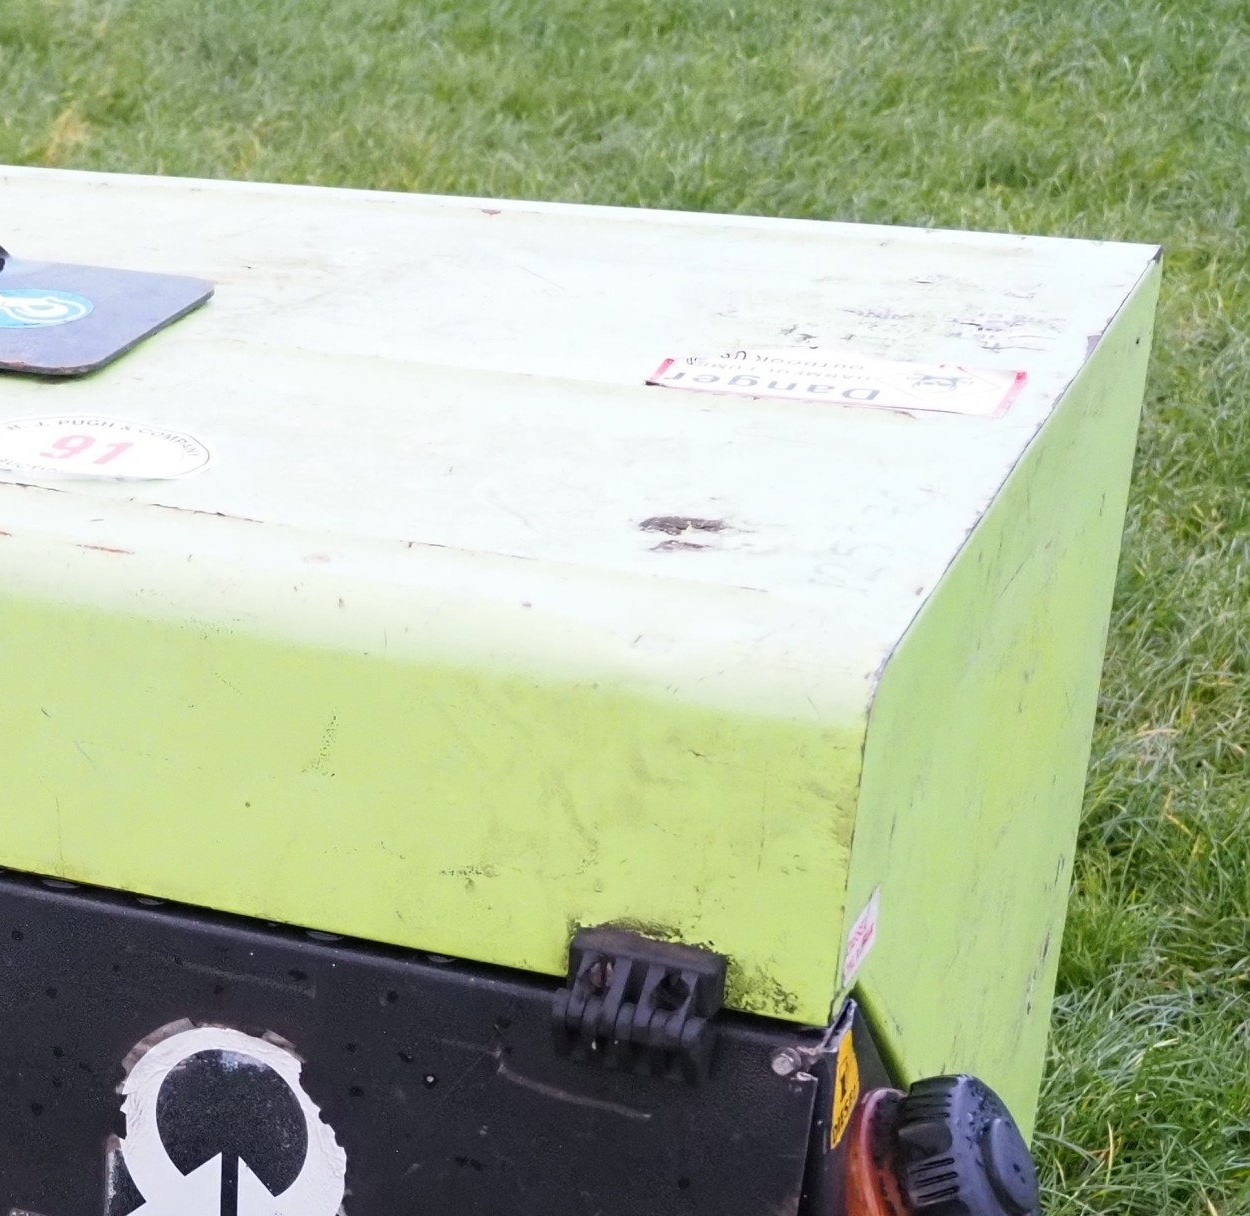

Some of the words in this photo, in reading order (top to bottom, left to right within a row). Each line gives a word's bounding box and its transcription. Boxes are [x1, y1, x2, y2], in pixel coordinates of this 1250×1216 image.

[663, 372, 880, 401] Danger
[58, 418, 115, 429] PUGH
[39, 434, 135, 465] 91
